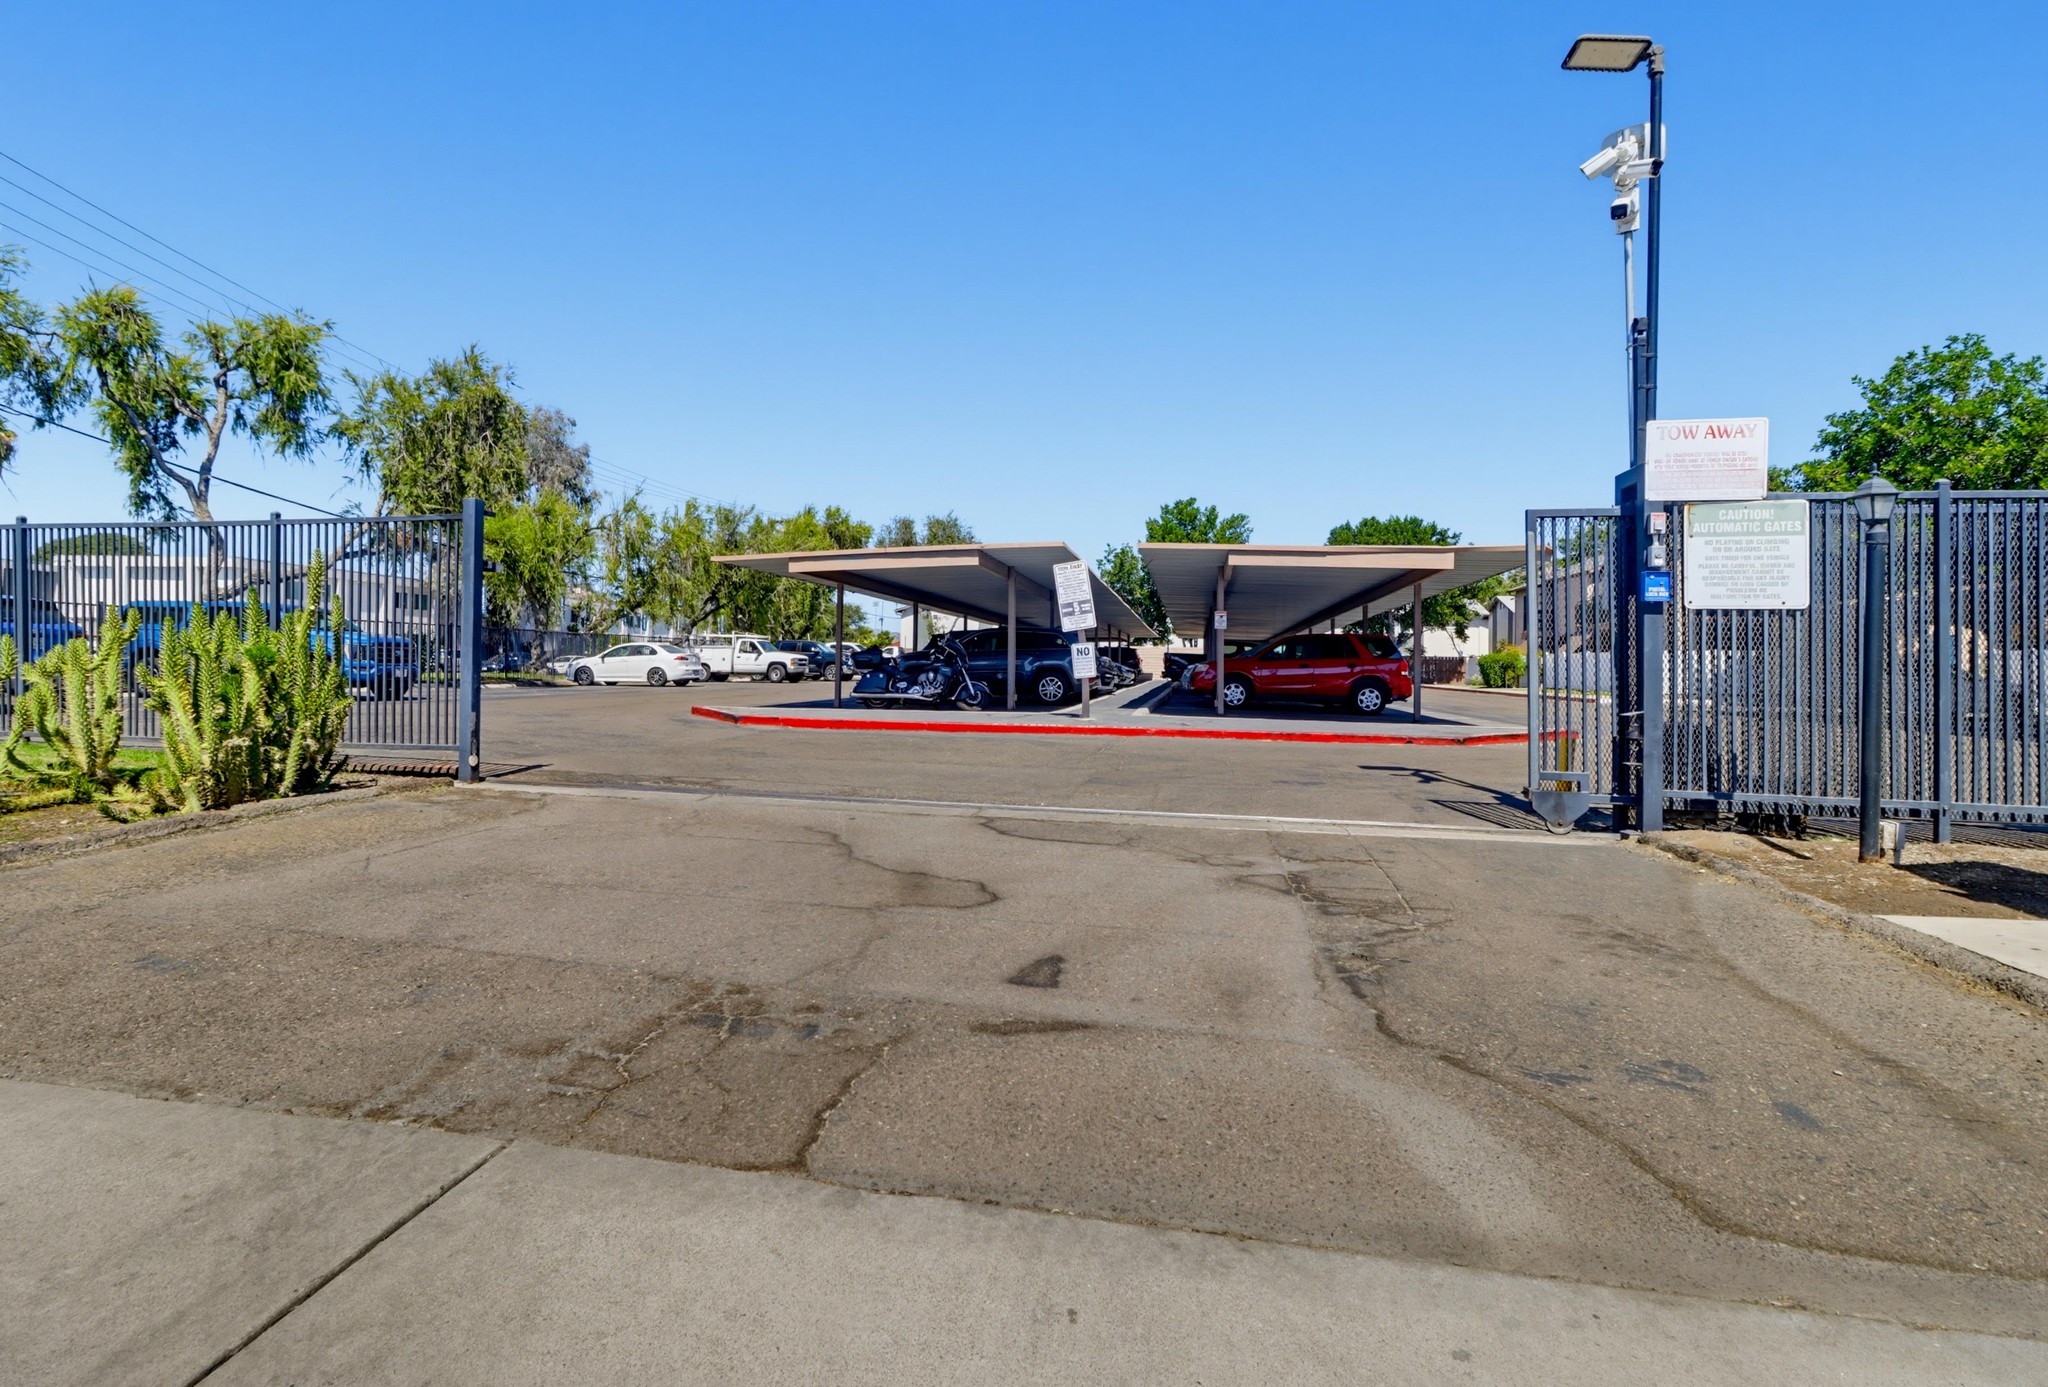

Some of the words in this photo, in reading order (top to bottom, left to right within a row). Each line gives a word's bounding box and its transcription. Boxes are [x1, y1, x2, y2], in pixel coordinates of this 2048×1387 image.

[1656, 425, 1700, 440] TOW
[1704, 423, 1758, 439] AWAY
[1718, 509, 1775, 520] CAUTION!
[1692, 522, 1761, 533] AUTOMATIC
[1764, 521, 1802, 532] GATES
[1076, 646, 1090, 656] NO
